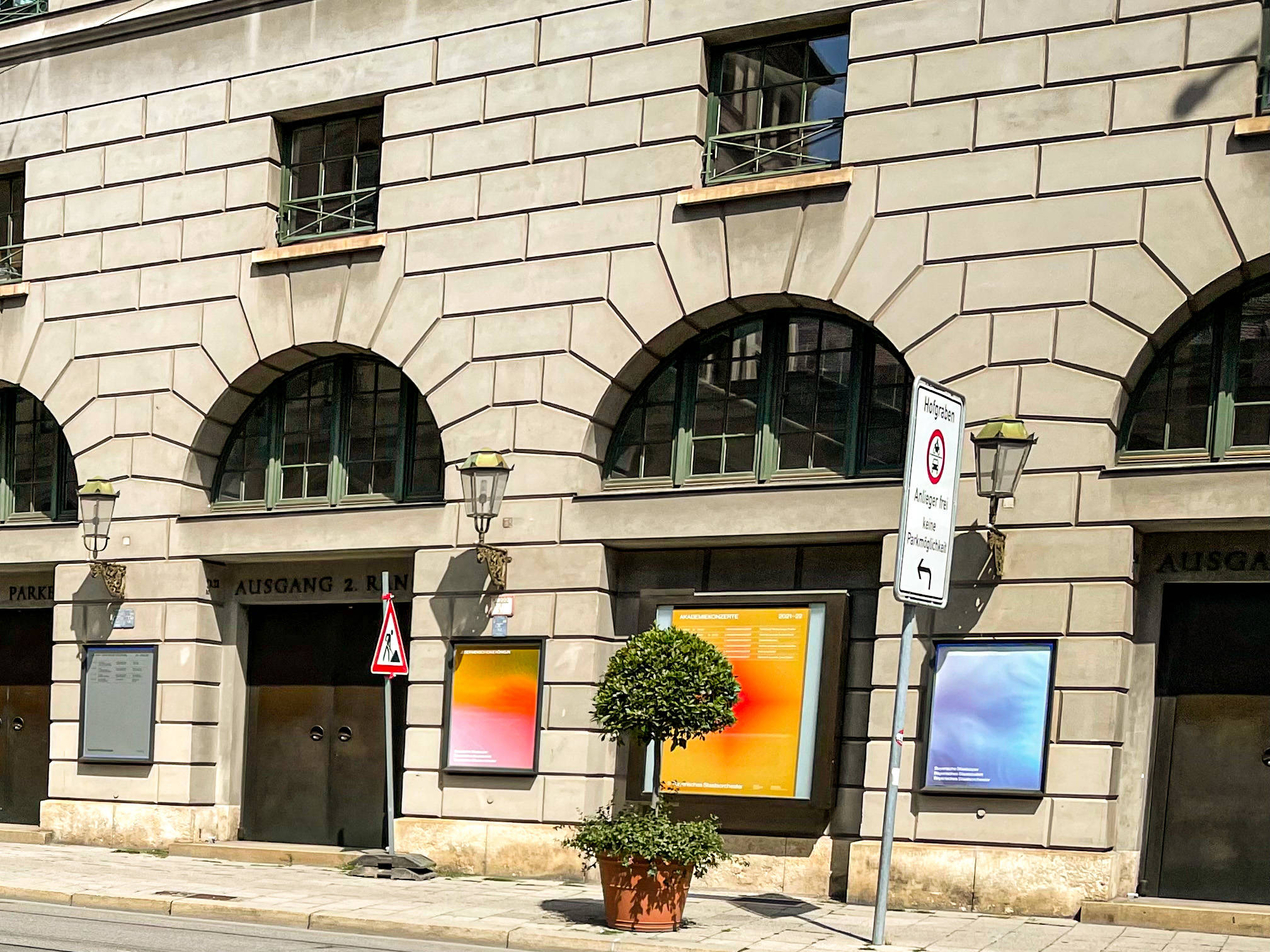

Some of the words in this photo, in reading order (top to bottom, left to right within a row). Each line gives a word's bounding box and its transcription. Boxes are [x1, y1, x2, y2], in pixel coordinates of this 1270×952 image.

[923, 396, 955, 424] Hofgraben
[914, 487, 939, 510] Anlieger
[939, 495, 949, 511] frei
[922, 517, 937, 532] keine
[907, 532, 947, 554] Parkmöglichkeit
[235, 577, 333, 596] AUSGANG
[344, 578, 358, 592] 2.
